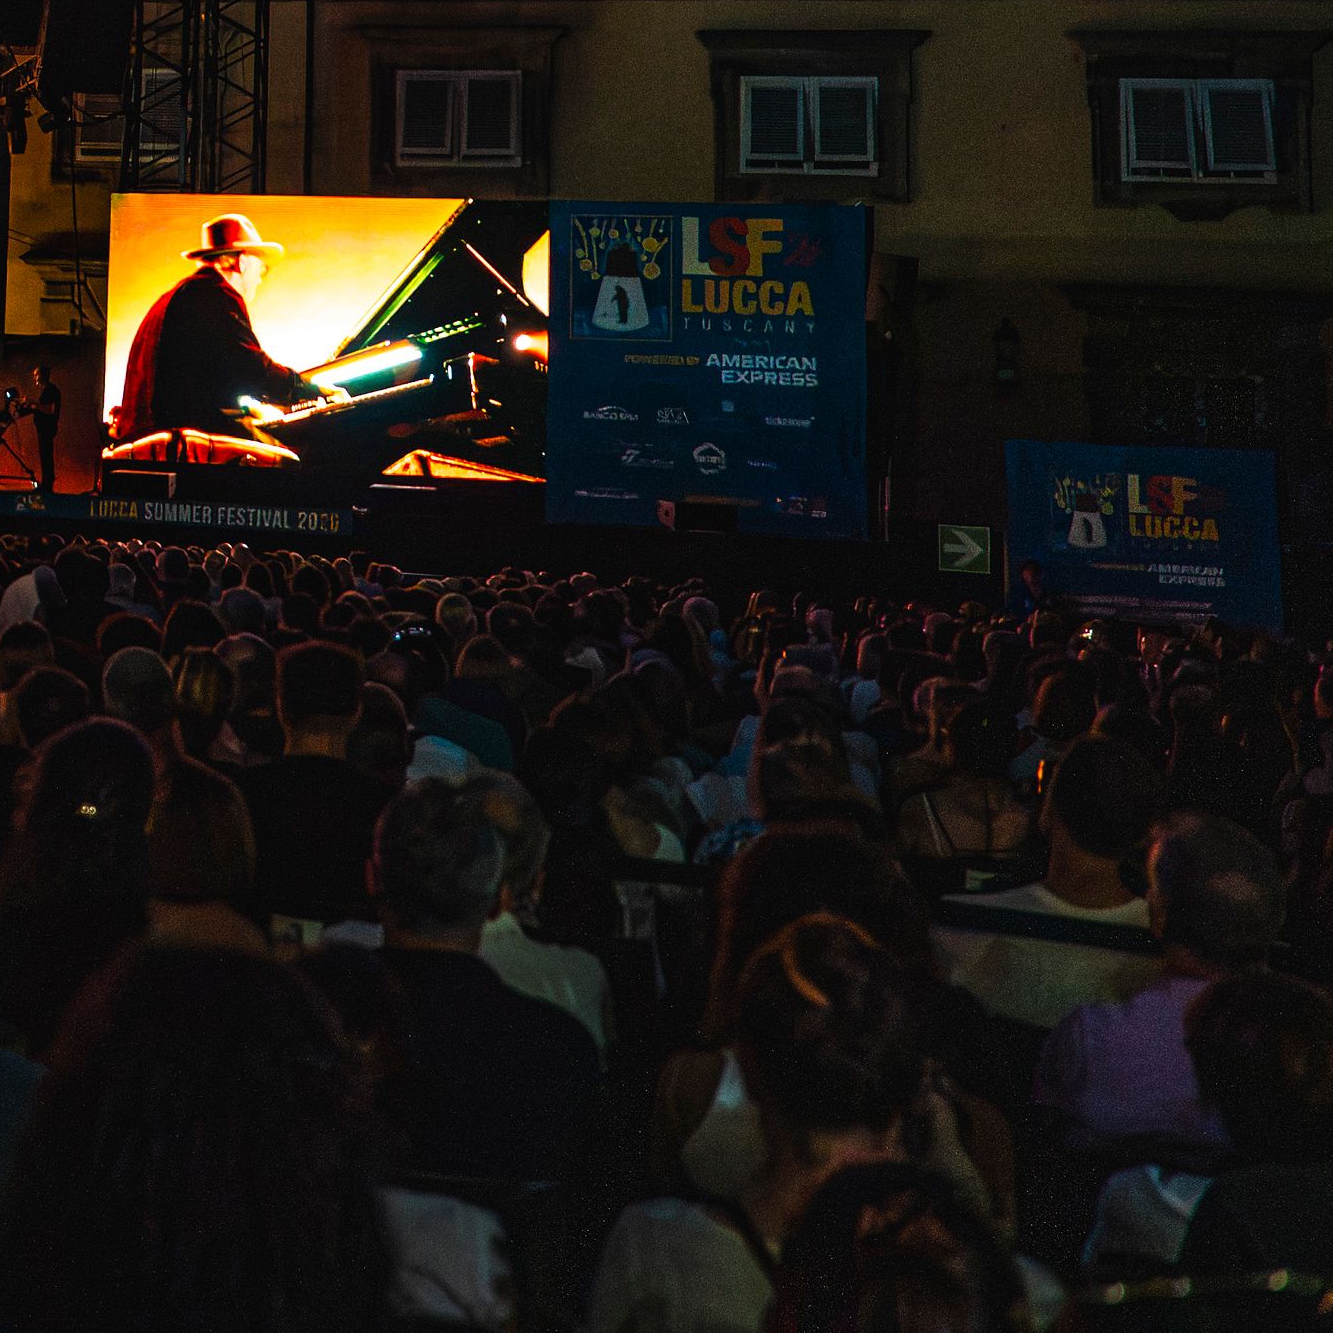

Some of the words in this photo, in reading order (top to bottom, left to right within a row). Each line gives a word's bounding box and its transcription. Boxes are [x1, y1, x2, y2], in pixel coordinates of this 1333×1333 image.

[681, 215, 784, 277] LSF
[681, 278, 815, 317] LUCCA
[683, 318, 815, 334] TUSCANY
[705, 353, 818, 371] AMERICAN
[721, 370, 819, 387] EXPRESS
[1127, 473, 1198, 516] LSF
[90, 499, 139, 519] LUCCA
[144, 502, 211, 525] SUMMER
[217, 506, 291, 530] FESTIVAL
[1128, 513, 1220, 542] LUCCA
[1147, 563, 1224, 576] AMERICAN
[1158, 575, 1226, 588] EXPRESS
